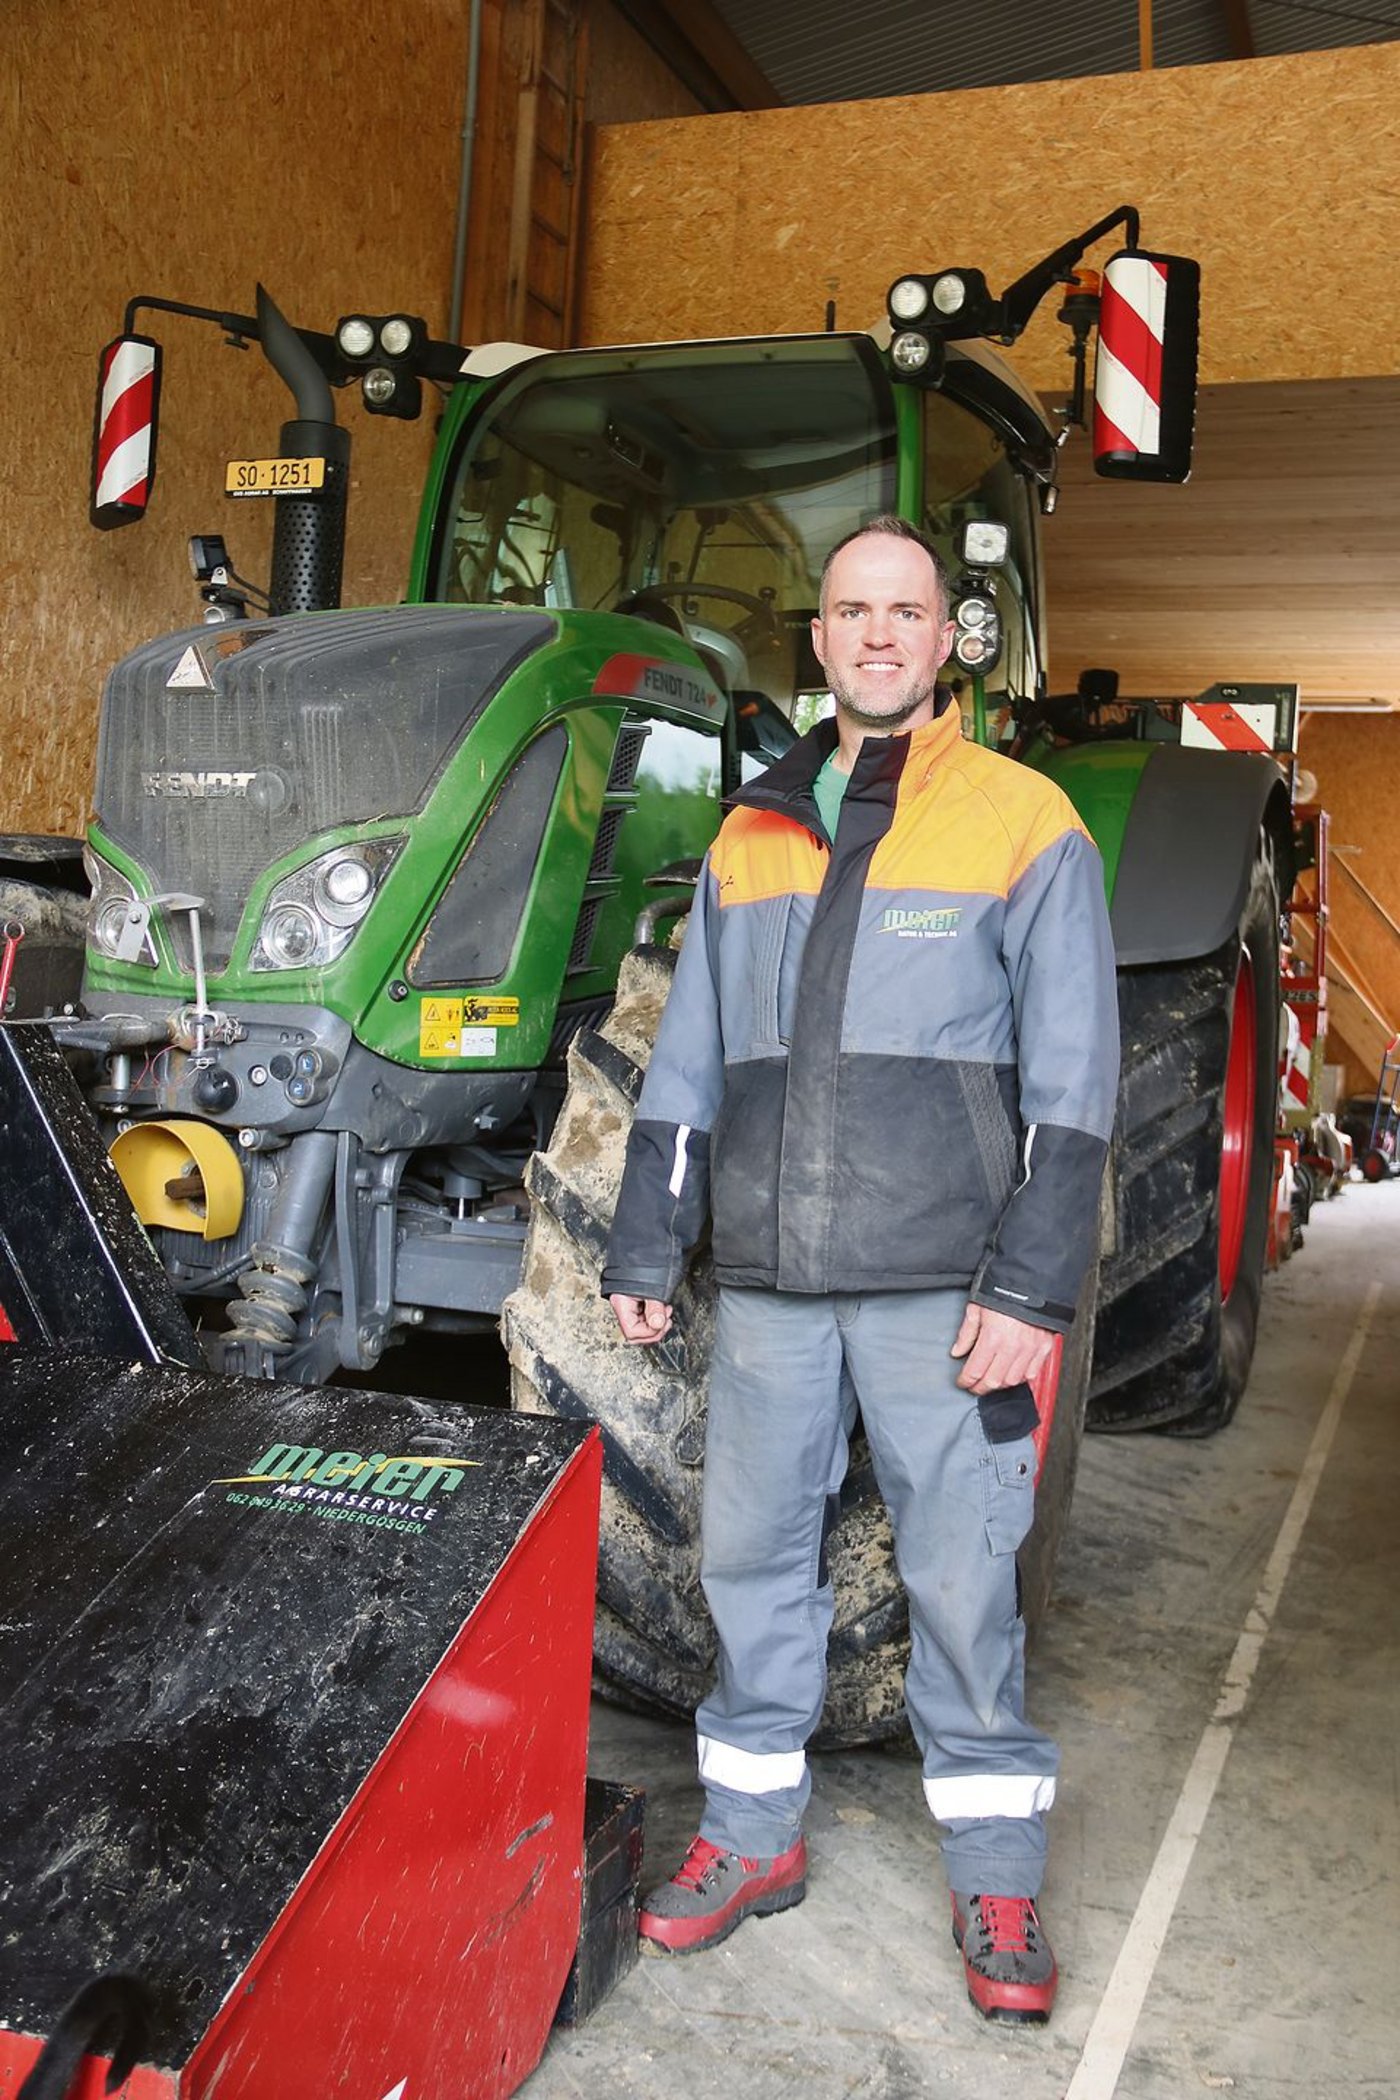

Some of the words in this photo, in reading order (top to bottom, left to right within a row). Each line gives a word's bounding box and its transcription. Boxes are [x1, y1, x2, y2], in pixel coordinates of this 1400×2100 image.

[270, 463, 310, 486] 1251
[645, 668, 683, 697] FENDT
[141, 772, 257, 799] FENDT
[884, 910, 959, 930] meier
[248, 1443, 465, 1501] meier
[272, 1483, 438, 1521] AGRARSERVICE
